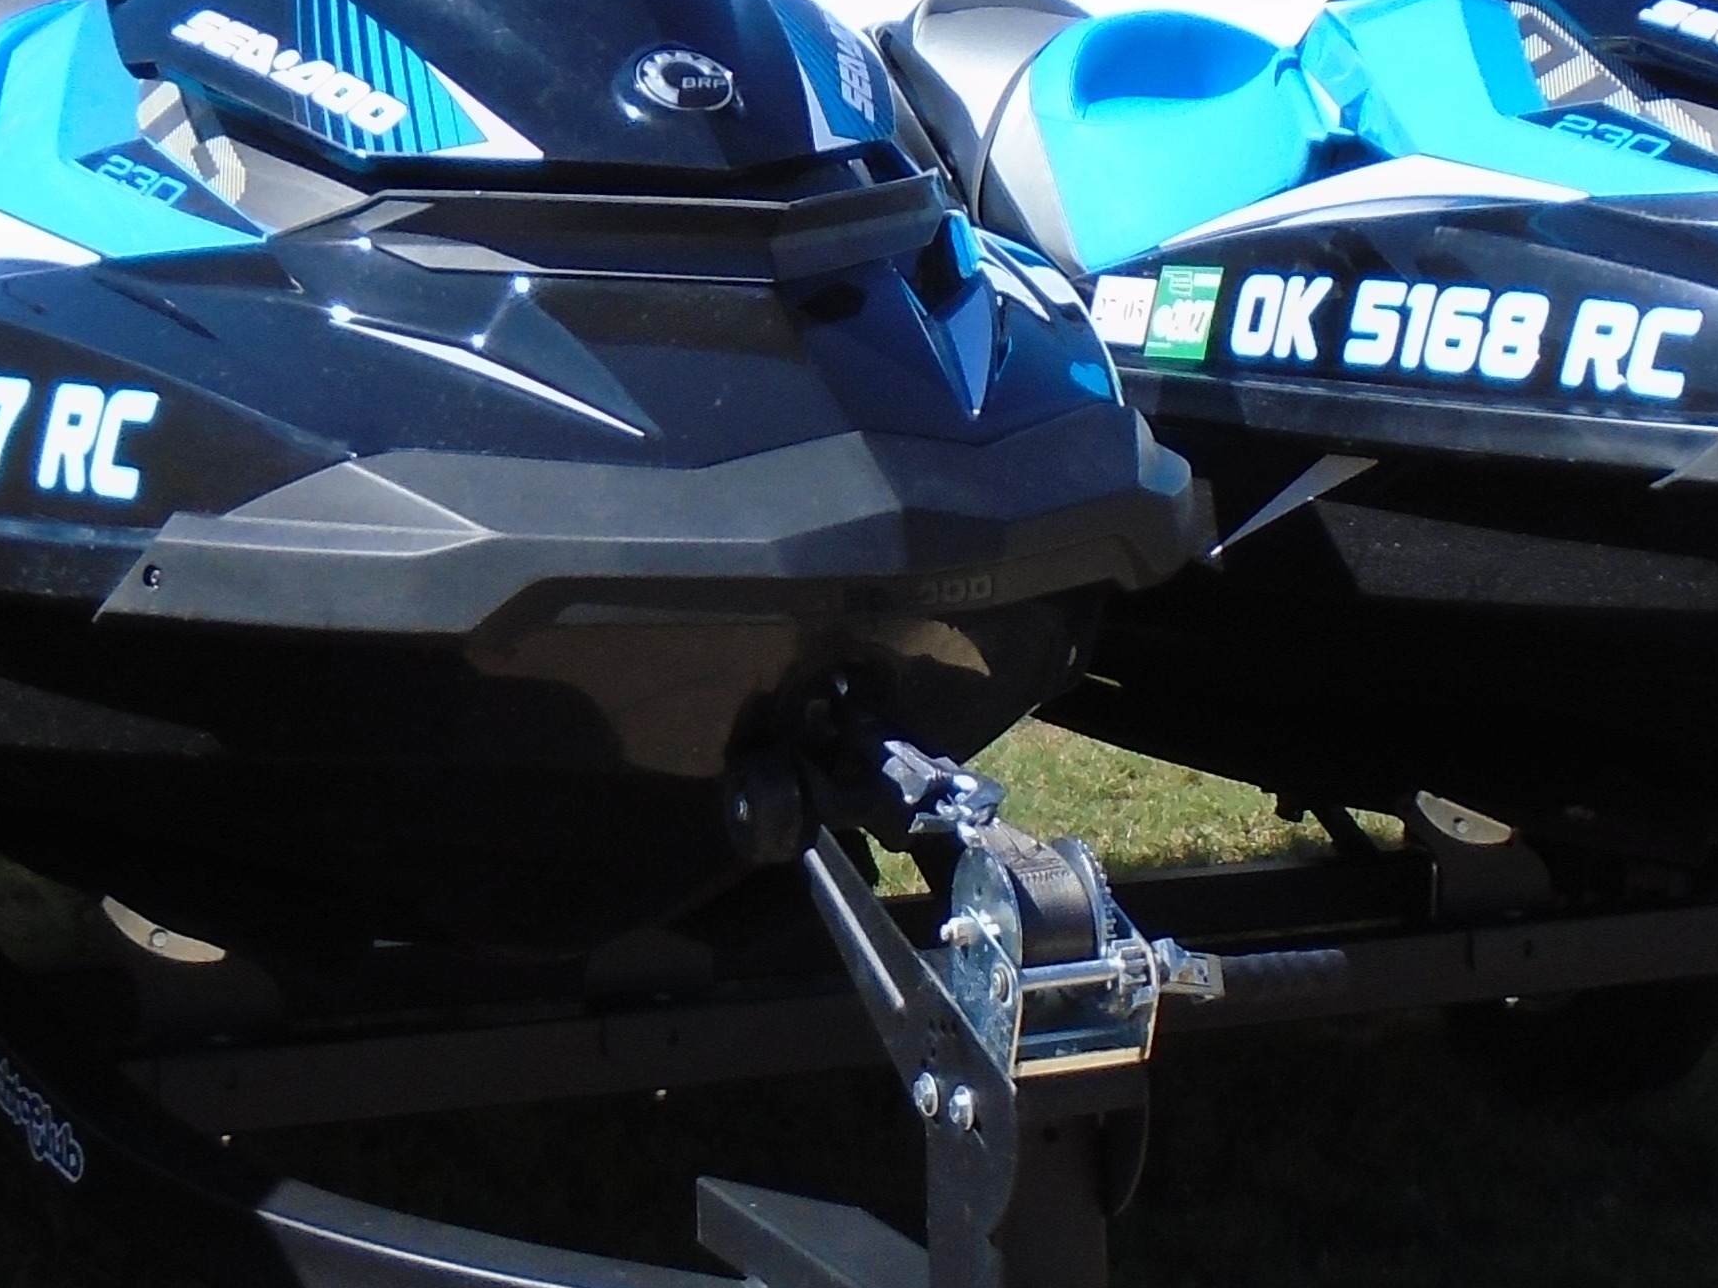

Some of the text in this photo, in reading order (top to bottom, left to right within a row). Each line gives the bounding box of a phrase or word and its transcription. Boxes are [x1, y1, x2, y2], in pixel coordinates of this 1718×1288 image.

[682, 76, 728, 90] BRP
[1551, 114, 1671, 159] 230
[95, 154, 188, 207] 230
[1229, 272, 1334, 362] OK
[1342, 278, 1551, 381] 5168
[1559, 297, 1704, 400] RC
[37, 382, 161, 502] RC
